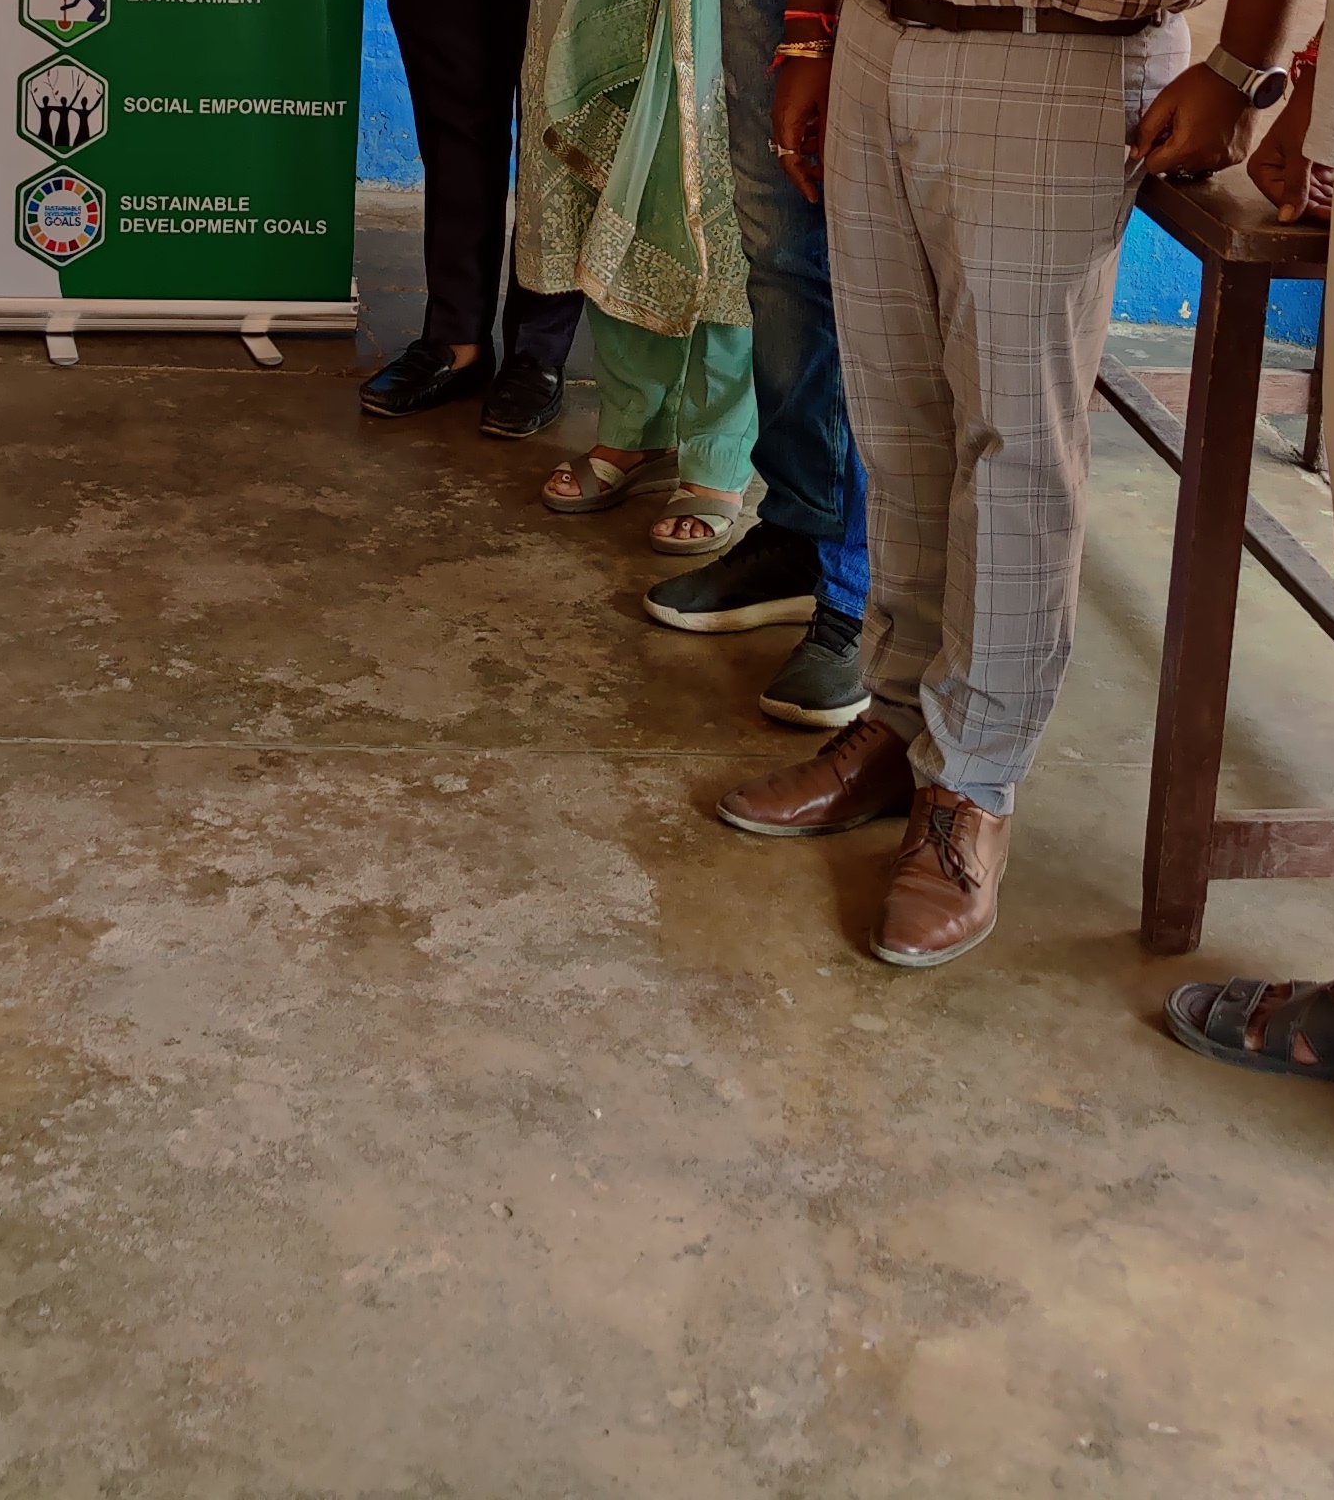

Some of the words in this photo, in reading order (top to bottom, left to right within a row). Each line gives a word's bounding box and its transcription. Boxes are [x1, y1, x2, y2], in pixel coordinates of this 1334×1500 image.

[123, 97, 194, 115] SOCIAL
[199, 98, 347, 116] EMPOWERMENT
[120, 196, 250, 212] SUSTAINABLE
[44, 216, 82, 227] GOALS
[120, 218, 259, 234] DEVELOPMENT
[263, 219, 327, 235] GOALS
